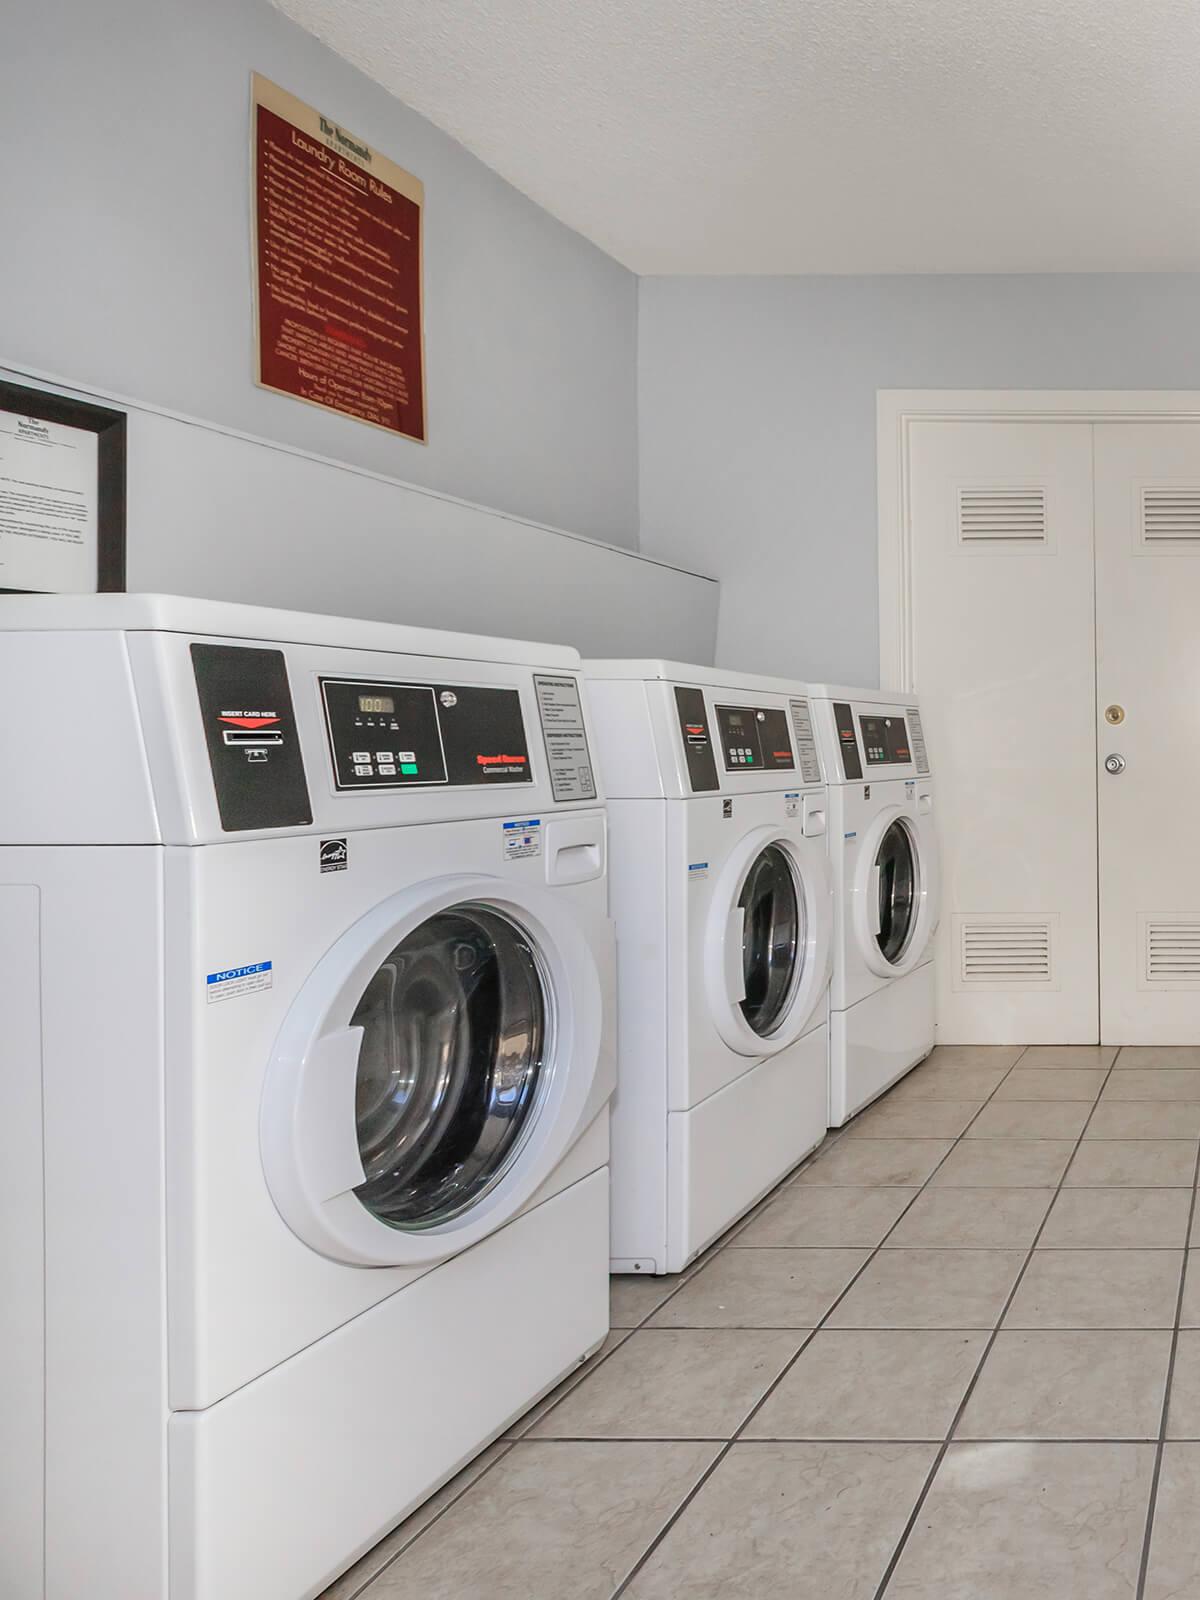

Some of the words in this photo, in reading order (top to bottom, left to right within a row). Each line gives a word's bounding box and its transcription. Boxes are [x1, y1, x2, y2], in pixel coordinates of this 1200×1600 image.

[292, 130, 335, 170] Laundry
[338, 160, 367, 186] Room
[369, 179, 393, 204] Rules
[215, 963, 265, 982] NOTICE
